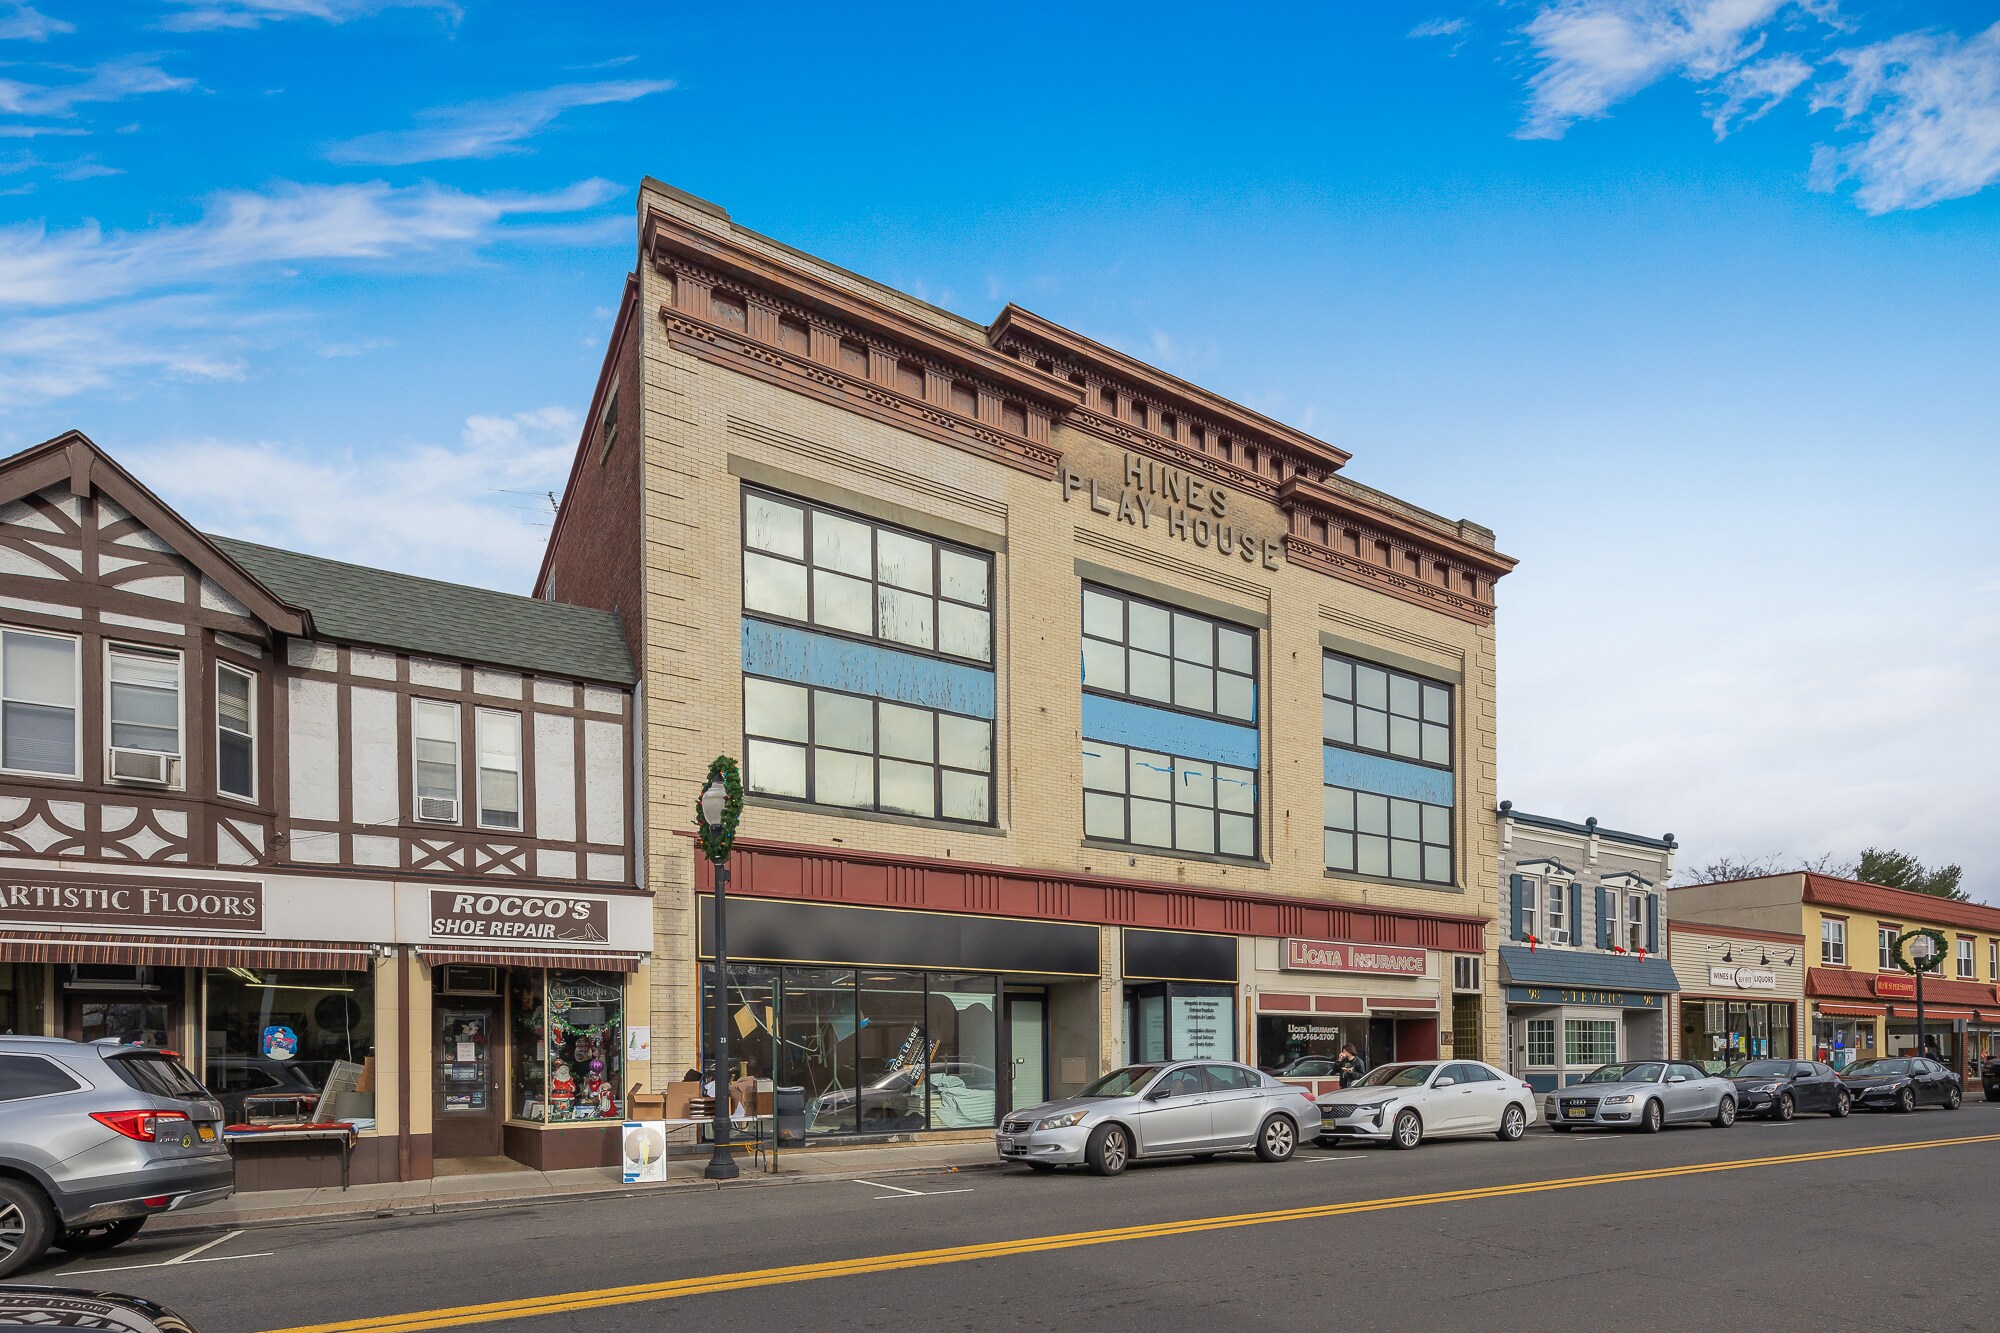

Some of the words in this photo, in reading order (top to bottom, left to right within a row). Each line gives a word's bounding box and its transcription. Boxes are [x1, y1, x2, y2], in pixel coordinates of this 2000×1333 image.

[1124, 452, 1229, 517] HINES
[1062, 467, 1154, 529] PLAY
[1168, 505, 1279, 571] HOUSE
[140, 888, 256, 917] FLOORS
[452, 894, 592, 920] ROCCO'S
[432, 918, 487, 935] SHOE
[489, 921, 557, 938] REPAIR
[1348, 946, 1424, 971] INSURANCE
[1713, 972, 1729, 980] WINES
[1754, 975, 1774, 984] LIQUORS
[1528, 988, 1540, 1000] 98
[1561, 990, 1624, 1005] STEVENS
[1643, 995, 1654, 1006] 98
[893, 1054, 906, 1071] FOR
[903, 1027, 919, 1053] LEASE
